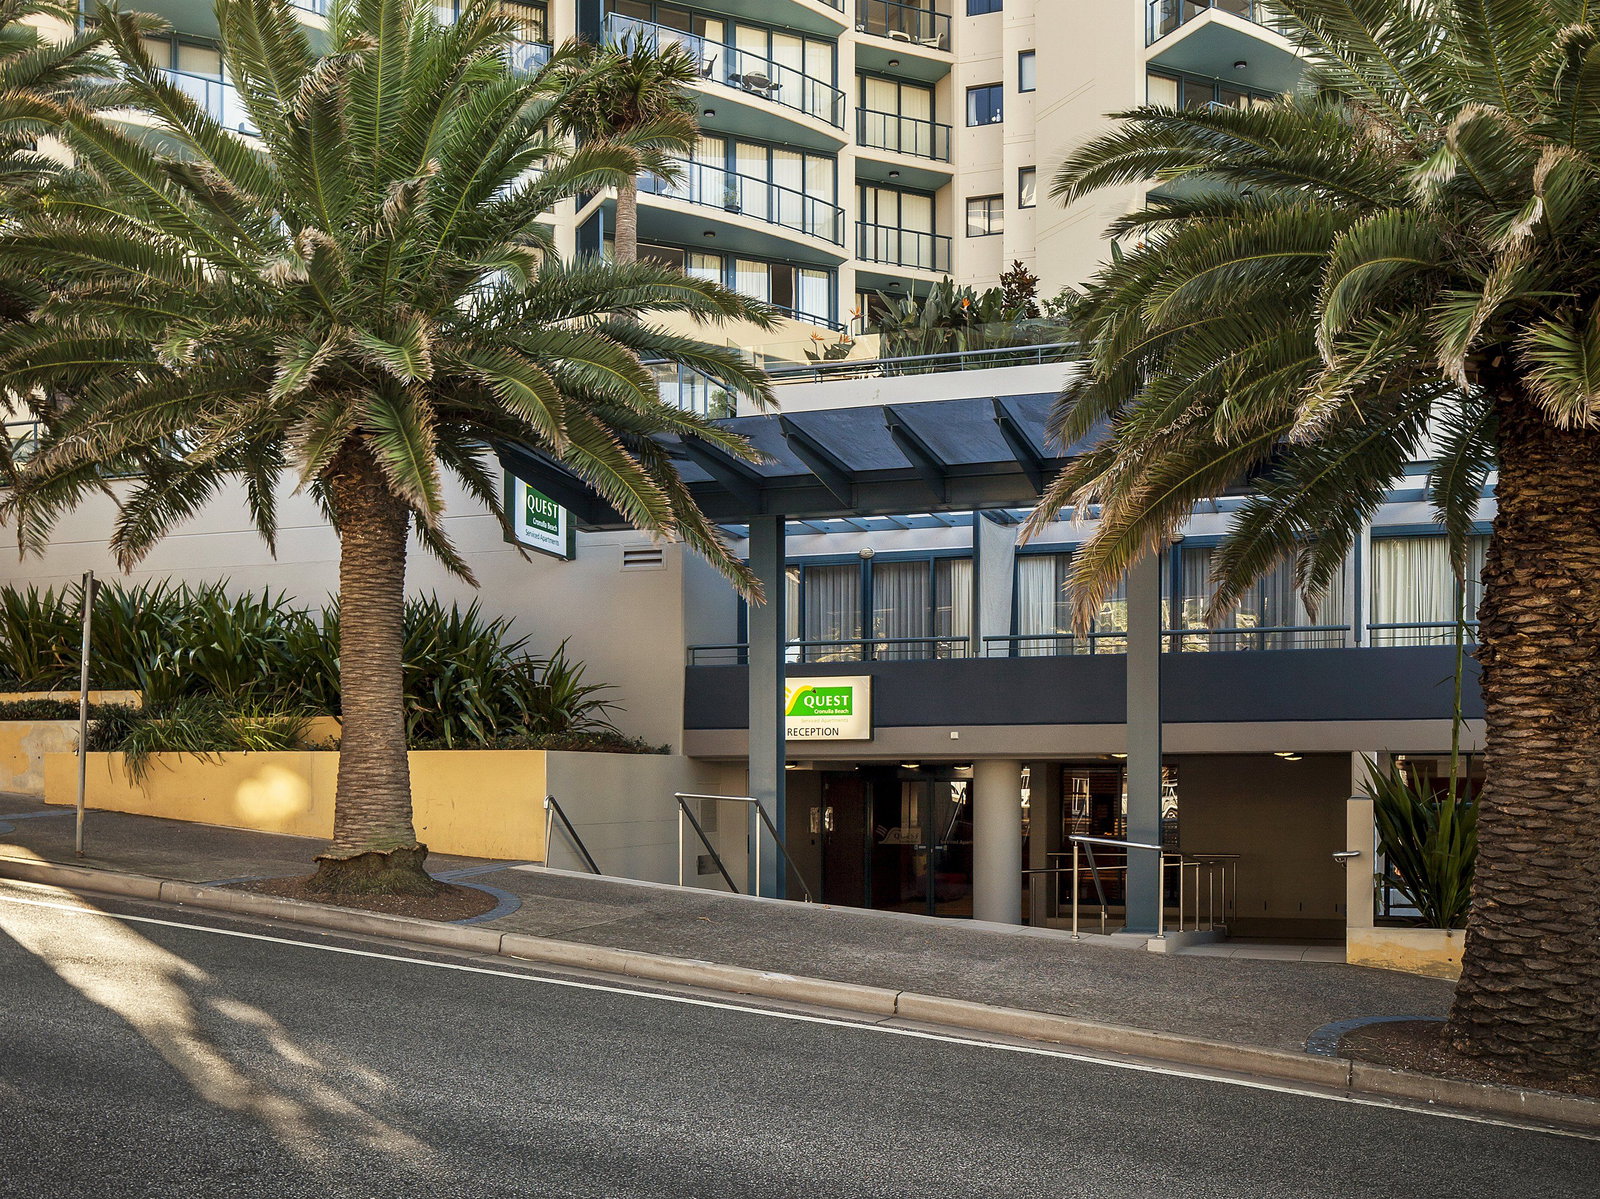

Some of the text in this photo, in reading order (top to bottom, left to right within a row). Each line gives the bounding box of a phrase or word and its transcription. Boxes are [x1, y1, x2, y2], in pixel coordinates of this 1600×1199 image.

[527, 494, 558, 519] QUEST
[532, 517, 558, 532] Cronulla Beach
[803, 695, 849, 709] QUEST
[787, 727, 839, 737] RECEPTION
